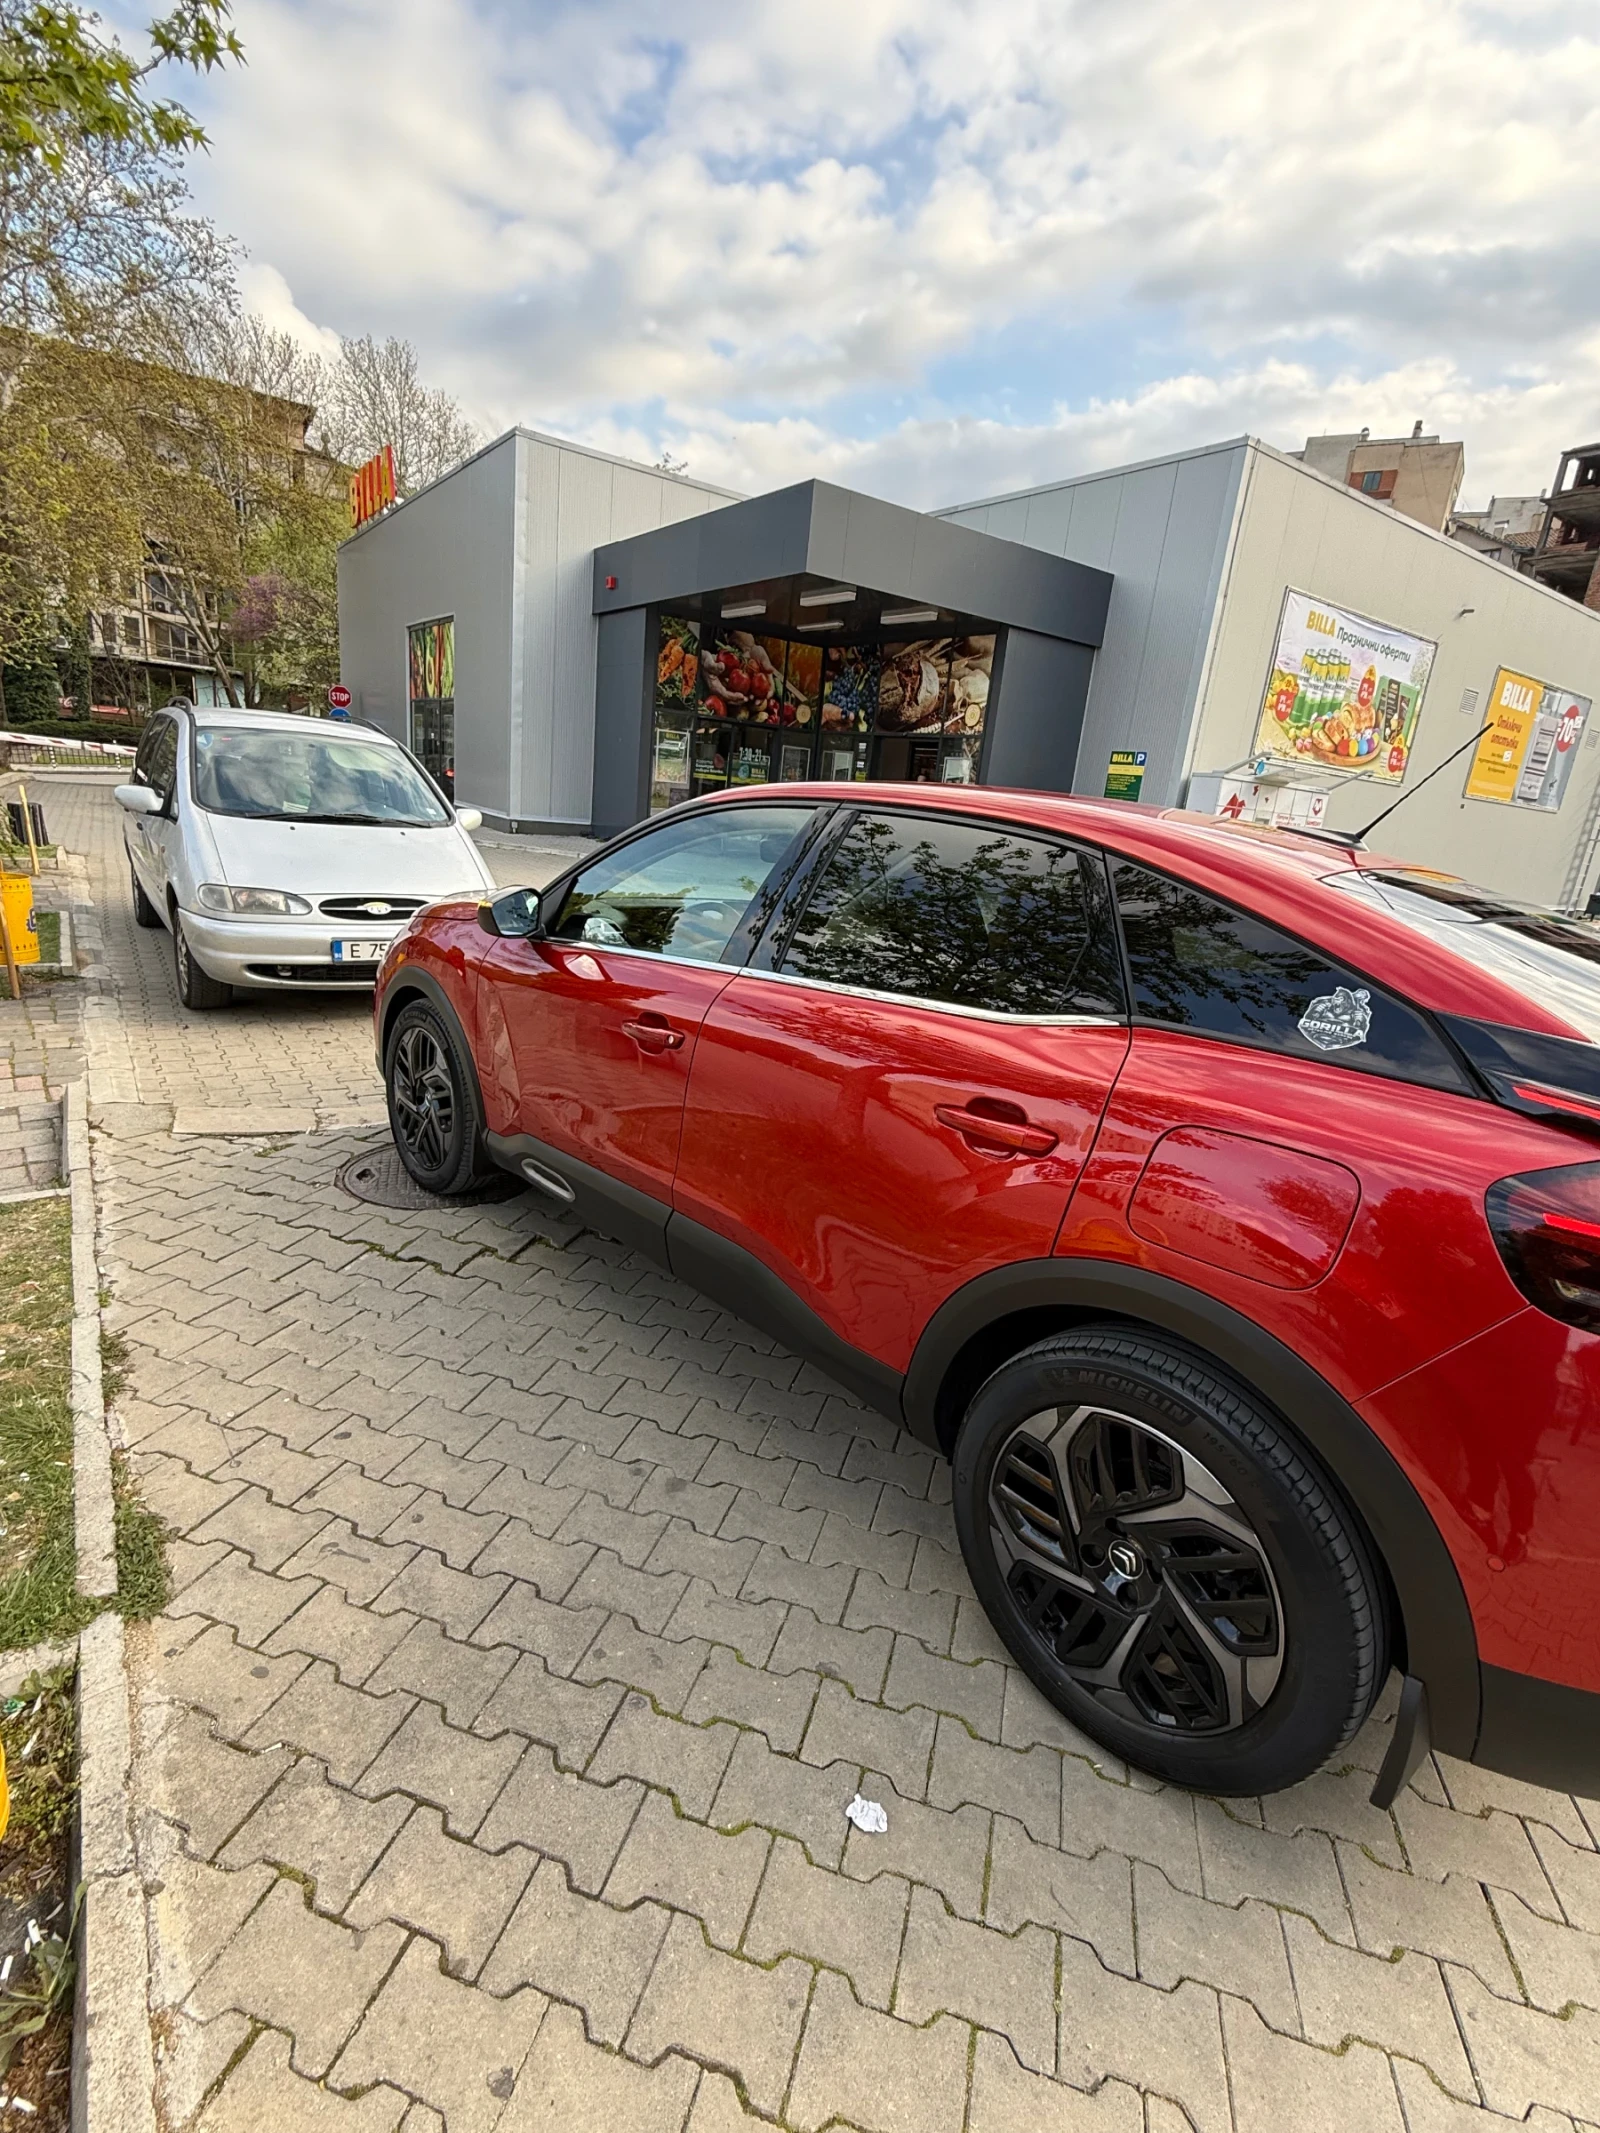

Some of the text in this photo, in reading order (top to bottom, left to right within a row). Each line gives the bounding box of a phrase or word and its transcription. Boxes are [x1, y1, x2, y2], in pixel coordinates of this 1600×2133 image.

[350, 445, 395, 528] BILLA
[1306, 610, 1336, 637] BILLA
[1337, 626, 1412, 663] Празнични оферти
[331, 691, 350, 702] STOP
[1500, 681, 1533, 714] BILLA
[1112, 753, 1145, 765] BILLA P
[350, 943, 361, 958] E
[1301, 1019, 1364, 1040] GORILLA
[1078, 1370, 1190, 1423] MICHELIN
